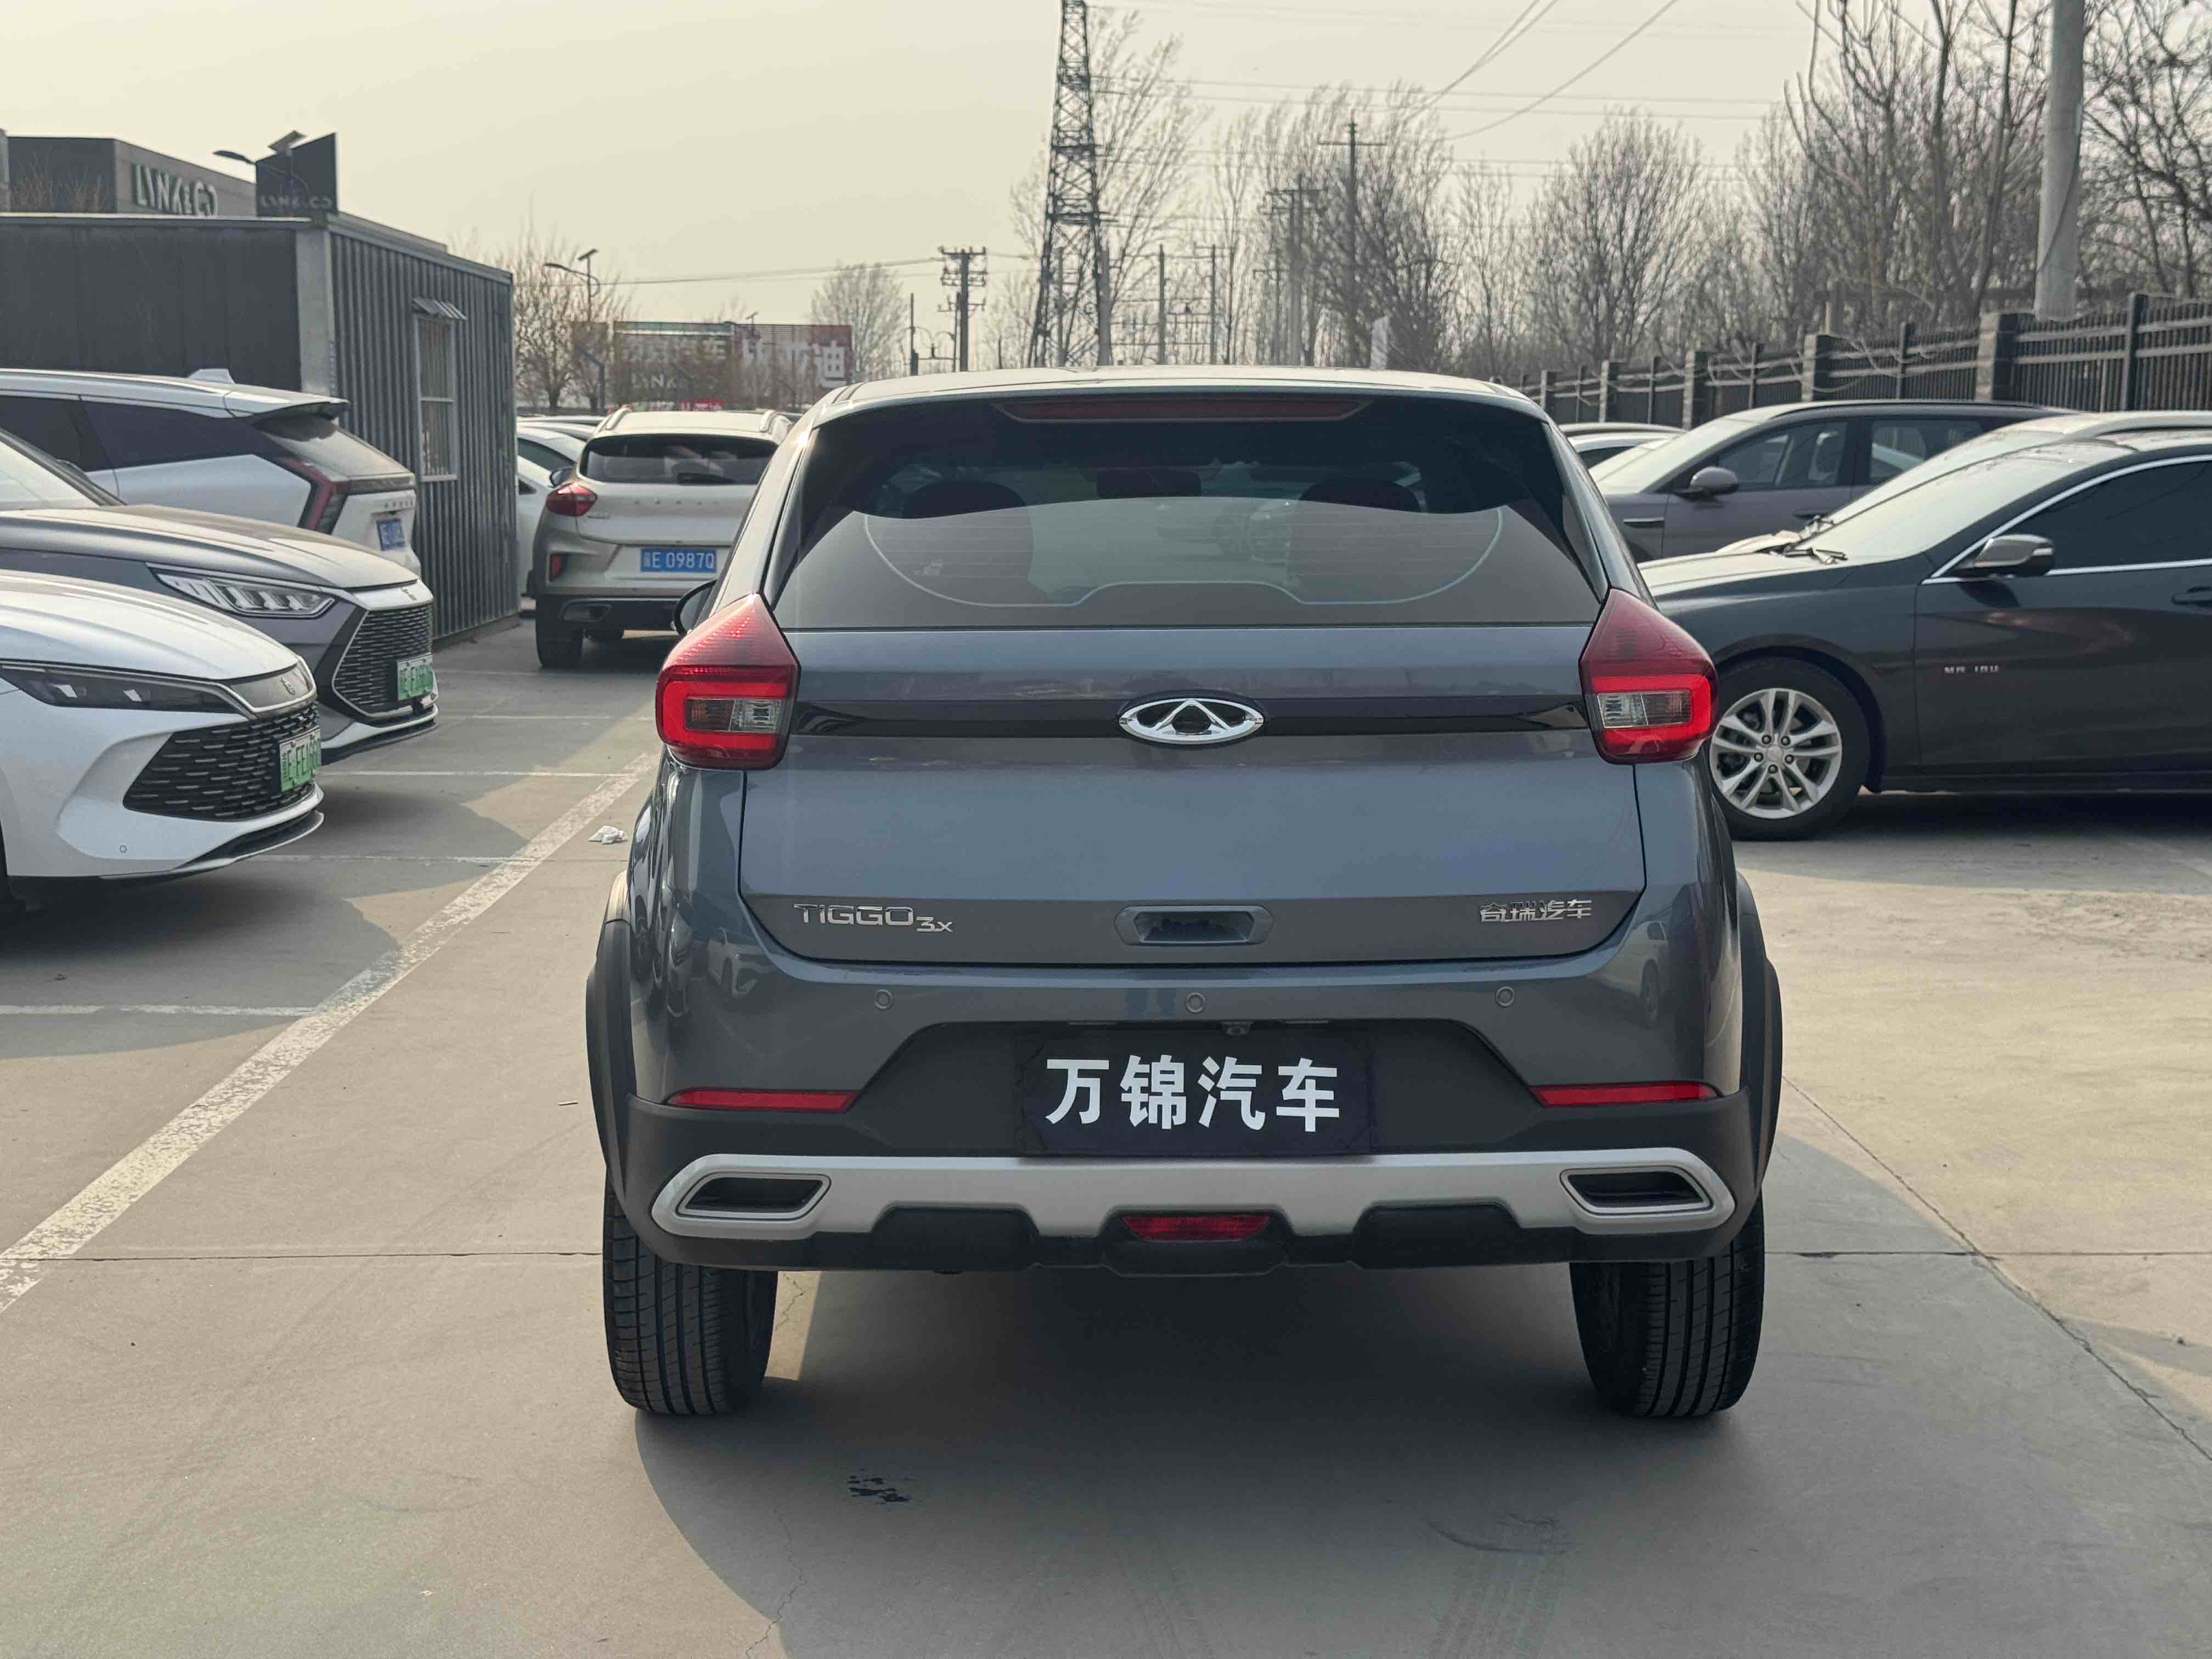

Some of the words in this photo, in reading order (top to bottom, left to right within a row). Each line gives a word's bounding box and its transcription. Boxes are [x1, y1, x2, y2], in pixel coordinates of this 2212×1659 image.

[1480, 899, 1593, 923] 奇瑞汽车
[1045, 1054, 1340, 1132] 万锦汽车
